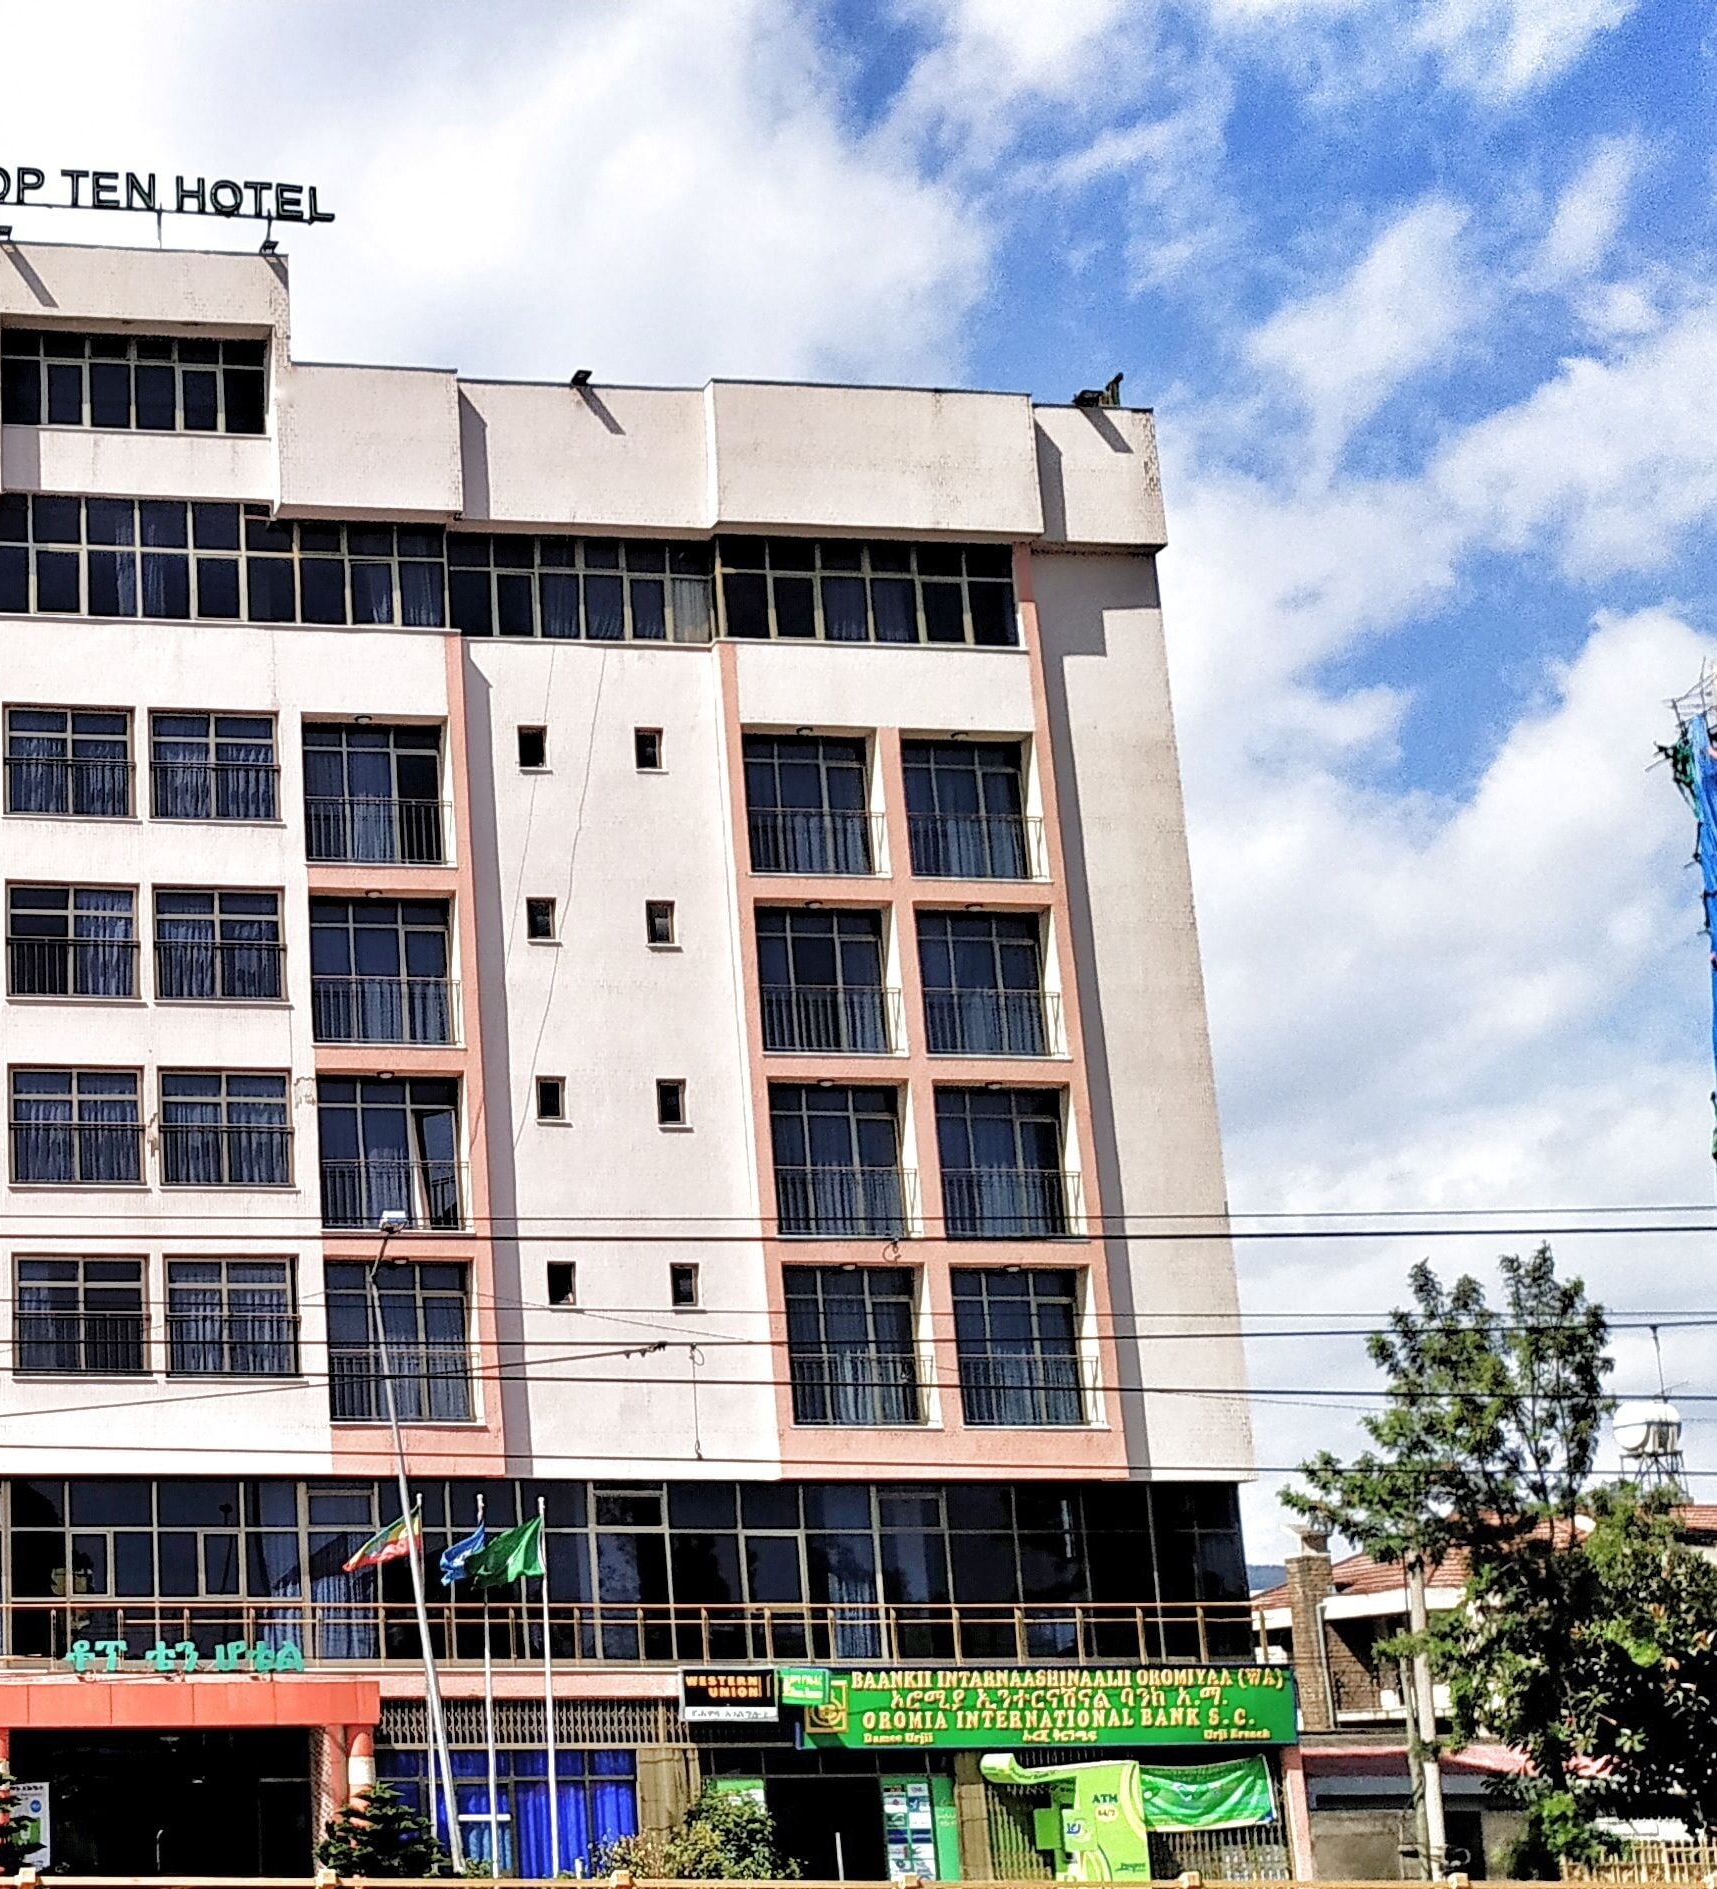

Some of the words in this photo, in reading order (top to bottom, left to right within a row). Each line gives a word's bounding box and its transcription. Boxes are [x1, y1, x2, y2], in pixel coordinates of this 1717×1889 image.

[61, 169, 155, 210] TEN
[176, 176, 335, 222] HOTEL
[65, 1640, 127, 1672] ቶፕ
[145, 1640, 199, 1672] ቴን
[215, 1640, 304, 1672] ሆቴል
[685, 1675, 758, 1687] WESTERN
[851, 1671, 931, 1689] BAANKII
[937, 1669, 1132, 1688] INTARNAASHINAALII
[1136, 1668, 1233, 1687] OROMIYAA
[708, 1687, 759, 1698] UNION
[862, 1711, 948, 1729] OROMIA
[956, 1708, 1135, 1729] INTERNATIONAL
[1140, 1708, 1201, 1727] BANK
[1092, 1794, 1118, 1804] ATM
